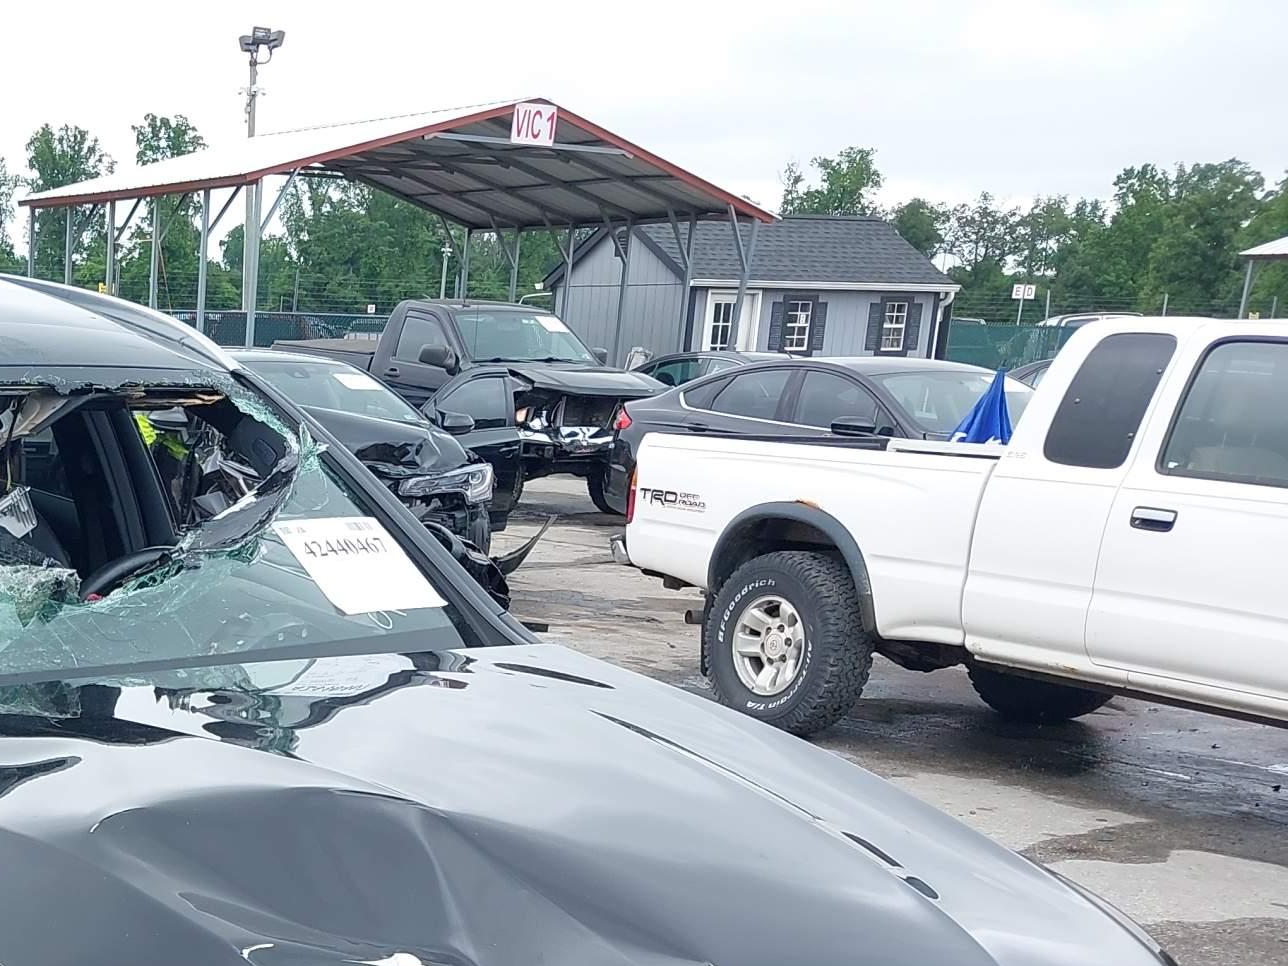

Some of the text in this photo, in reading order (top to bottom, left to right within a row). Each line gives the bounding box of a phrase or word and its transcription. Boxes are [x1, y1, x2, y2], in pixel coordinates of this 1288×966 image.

[516, 108, 556, 140] VIC 1
[640, 487, 678, 506] TRD
[304, 537, 387, 557] 42440467
[718, 578, 776, 643] BFGoodrich
[746, 700, 765, 710] T/A
